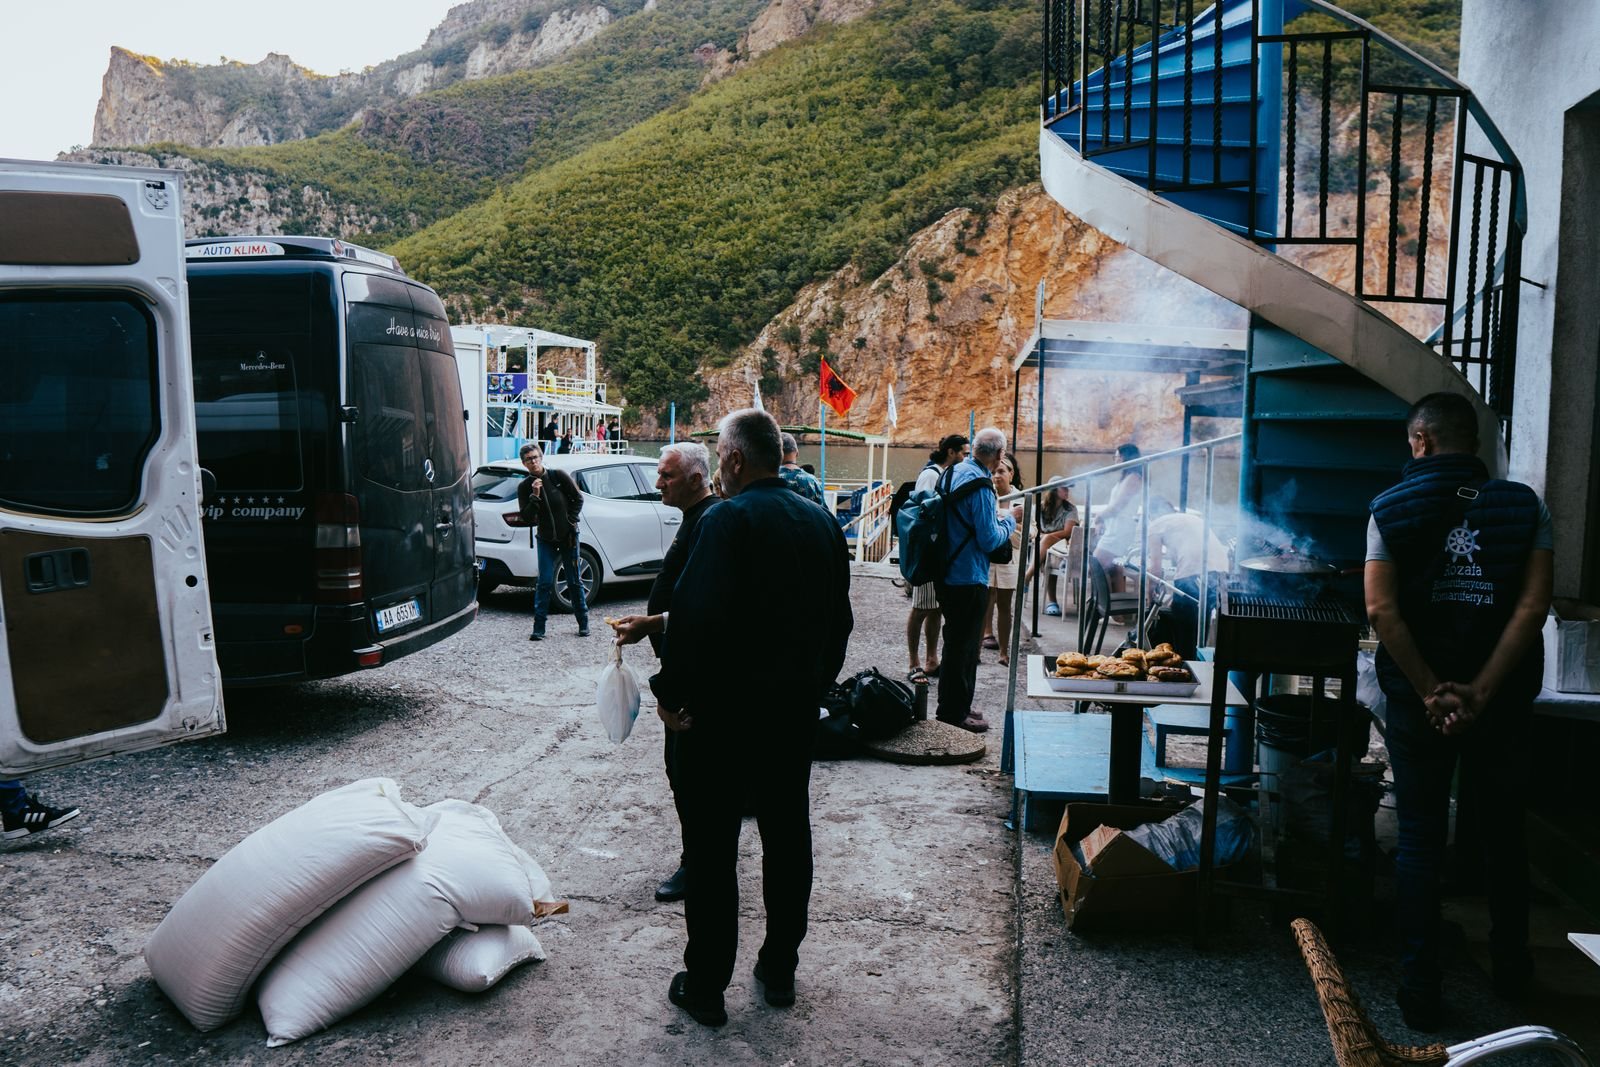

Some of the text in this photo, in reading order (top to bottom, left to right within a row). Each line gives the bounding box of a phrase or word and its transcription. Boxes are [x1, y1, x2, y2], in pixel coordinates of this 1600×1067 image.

[203, 245, 268, 256] AUTO KLIMA
[386, 316, 409, 336] Have
[409, 327, 415, 337] a
[416, 325, 429, 339] nice
[240, 361, 286, 371] Mercedes-Benz
[200, 504, 305, 520] vip company
[383, 610, 394, 626] AA
